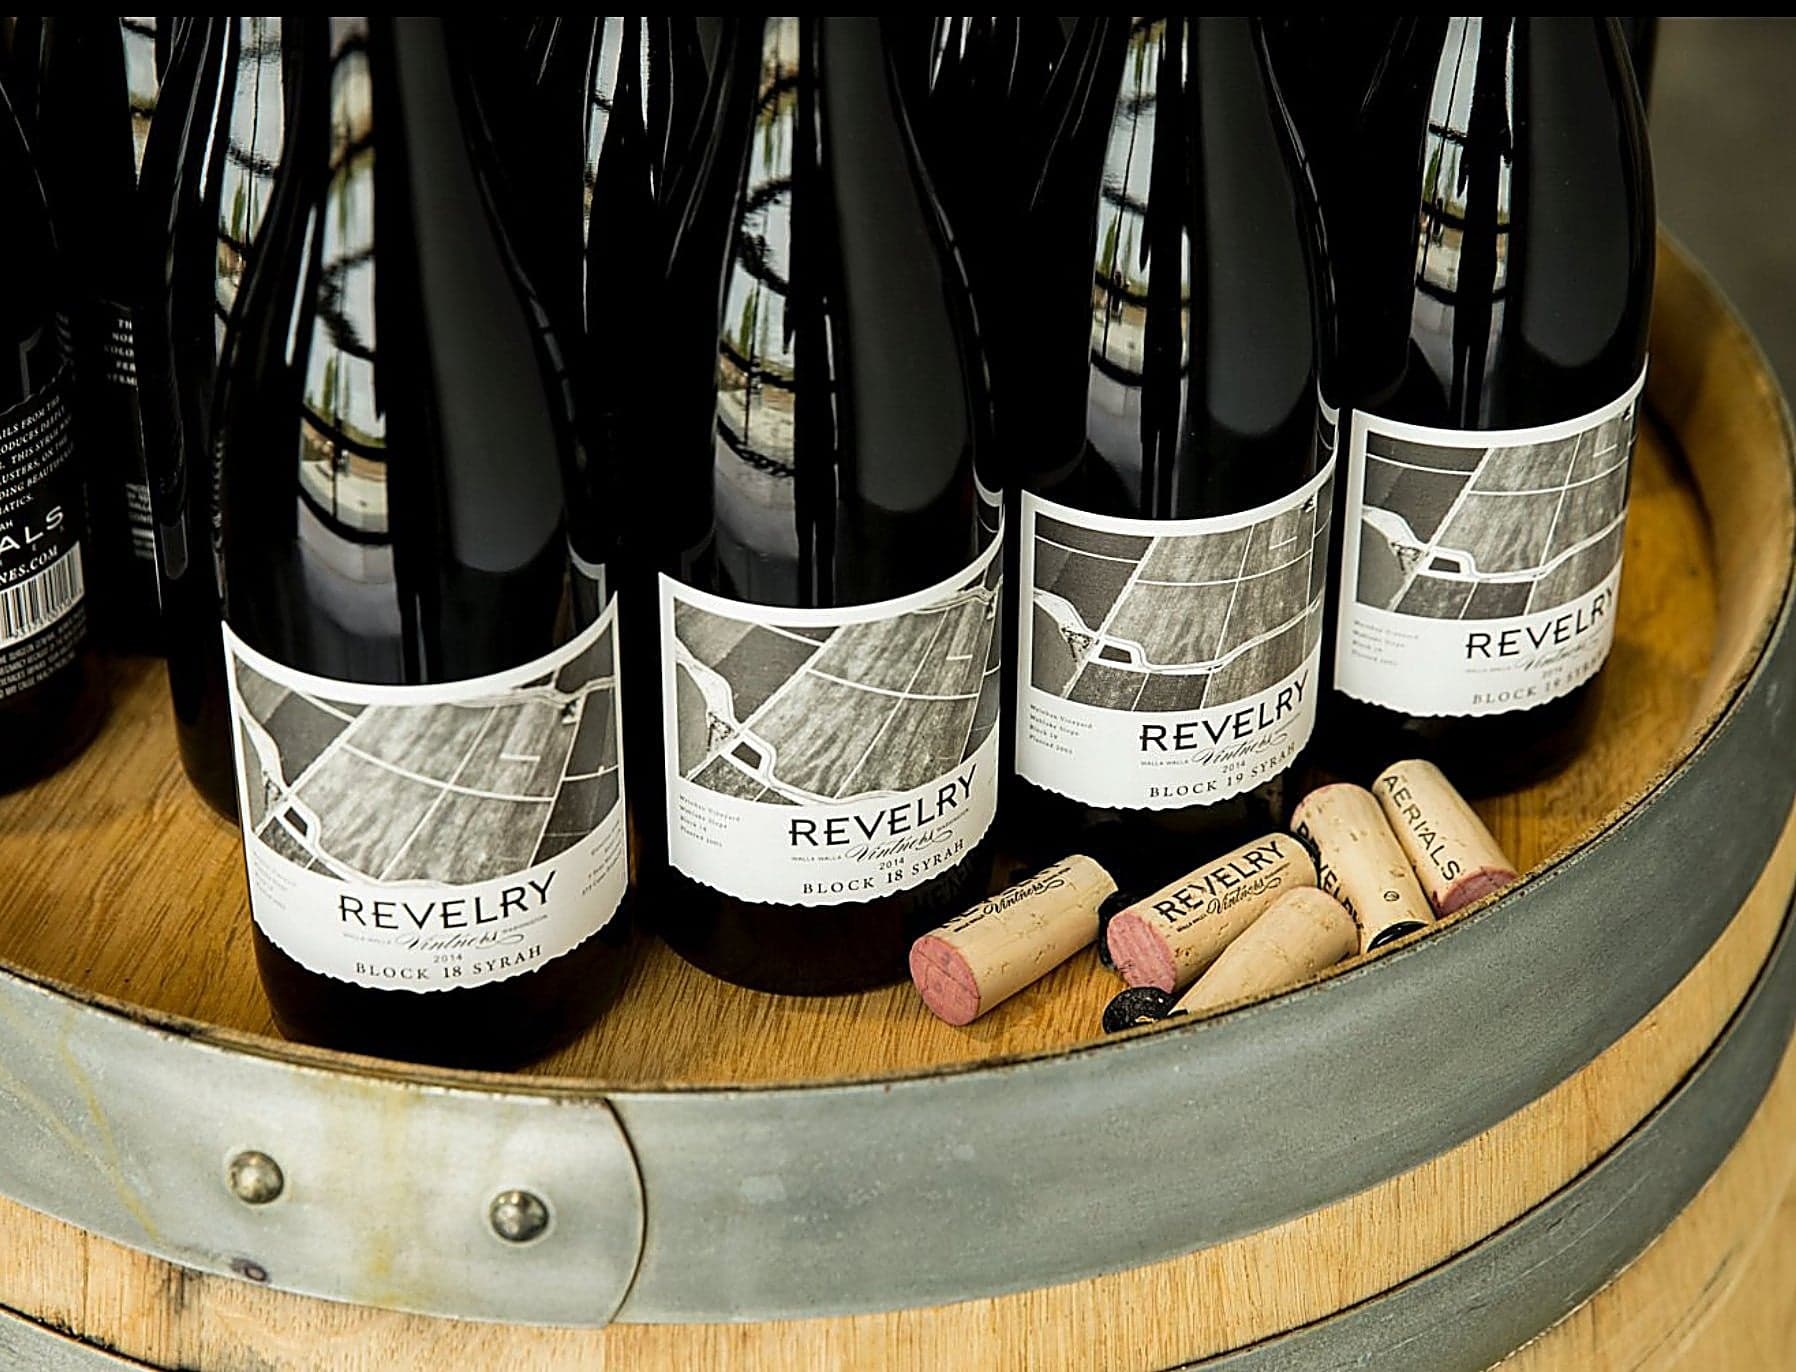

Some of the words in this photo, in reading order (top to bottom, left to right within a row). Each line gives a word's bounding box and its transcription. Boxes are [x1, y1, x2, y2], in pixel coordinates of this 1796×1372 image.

[0, 428, 38, 455] ODUCES
[11, 447, 34, 464] THIS
[1140, 669, 1309, 752] REVELRY
[1472, 686, 1537, 705] BLOCK
[1191, 732, 1288, 766] Vintners
[1150, 780, 1217, 798] BLOCK
[1227, 773, 1244, 786] 19
[1251, 742, 1296, 778] SYRAH
[1222, 760, 1246, 774] 2014
[788, 763, 977, 847] REVELRY
[1383, 774, 1461, 881] AERIALS
[845, 829, 953, 862] Vintners
[803, 877, 875, 894] BLOCK
[887, 869, 904, 884] 18
[911, 838, 964, 876] SYRAH
[879, 857, 905, 871] 2014
[1152, 840, 1285, 923] REVELRY
[338, 869, 558, 931] REVELRY
[983, 879, 1065, 914] Vintners
[1206, 877, 1282, 914] Vintners
[356, 961, 430, 980] BLOCK
[443, 966, 463, 979] 18
[472, 945, 541, 975] SYRAH
[433, 953, 463, 964] 2014
